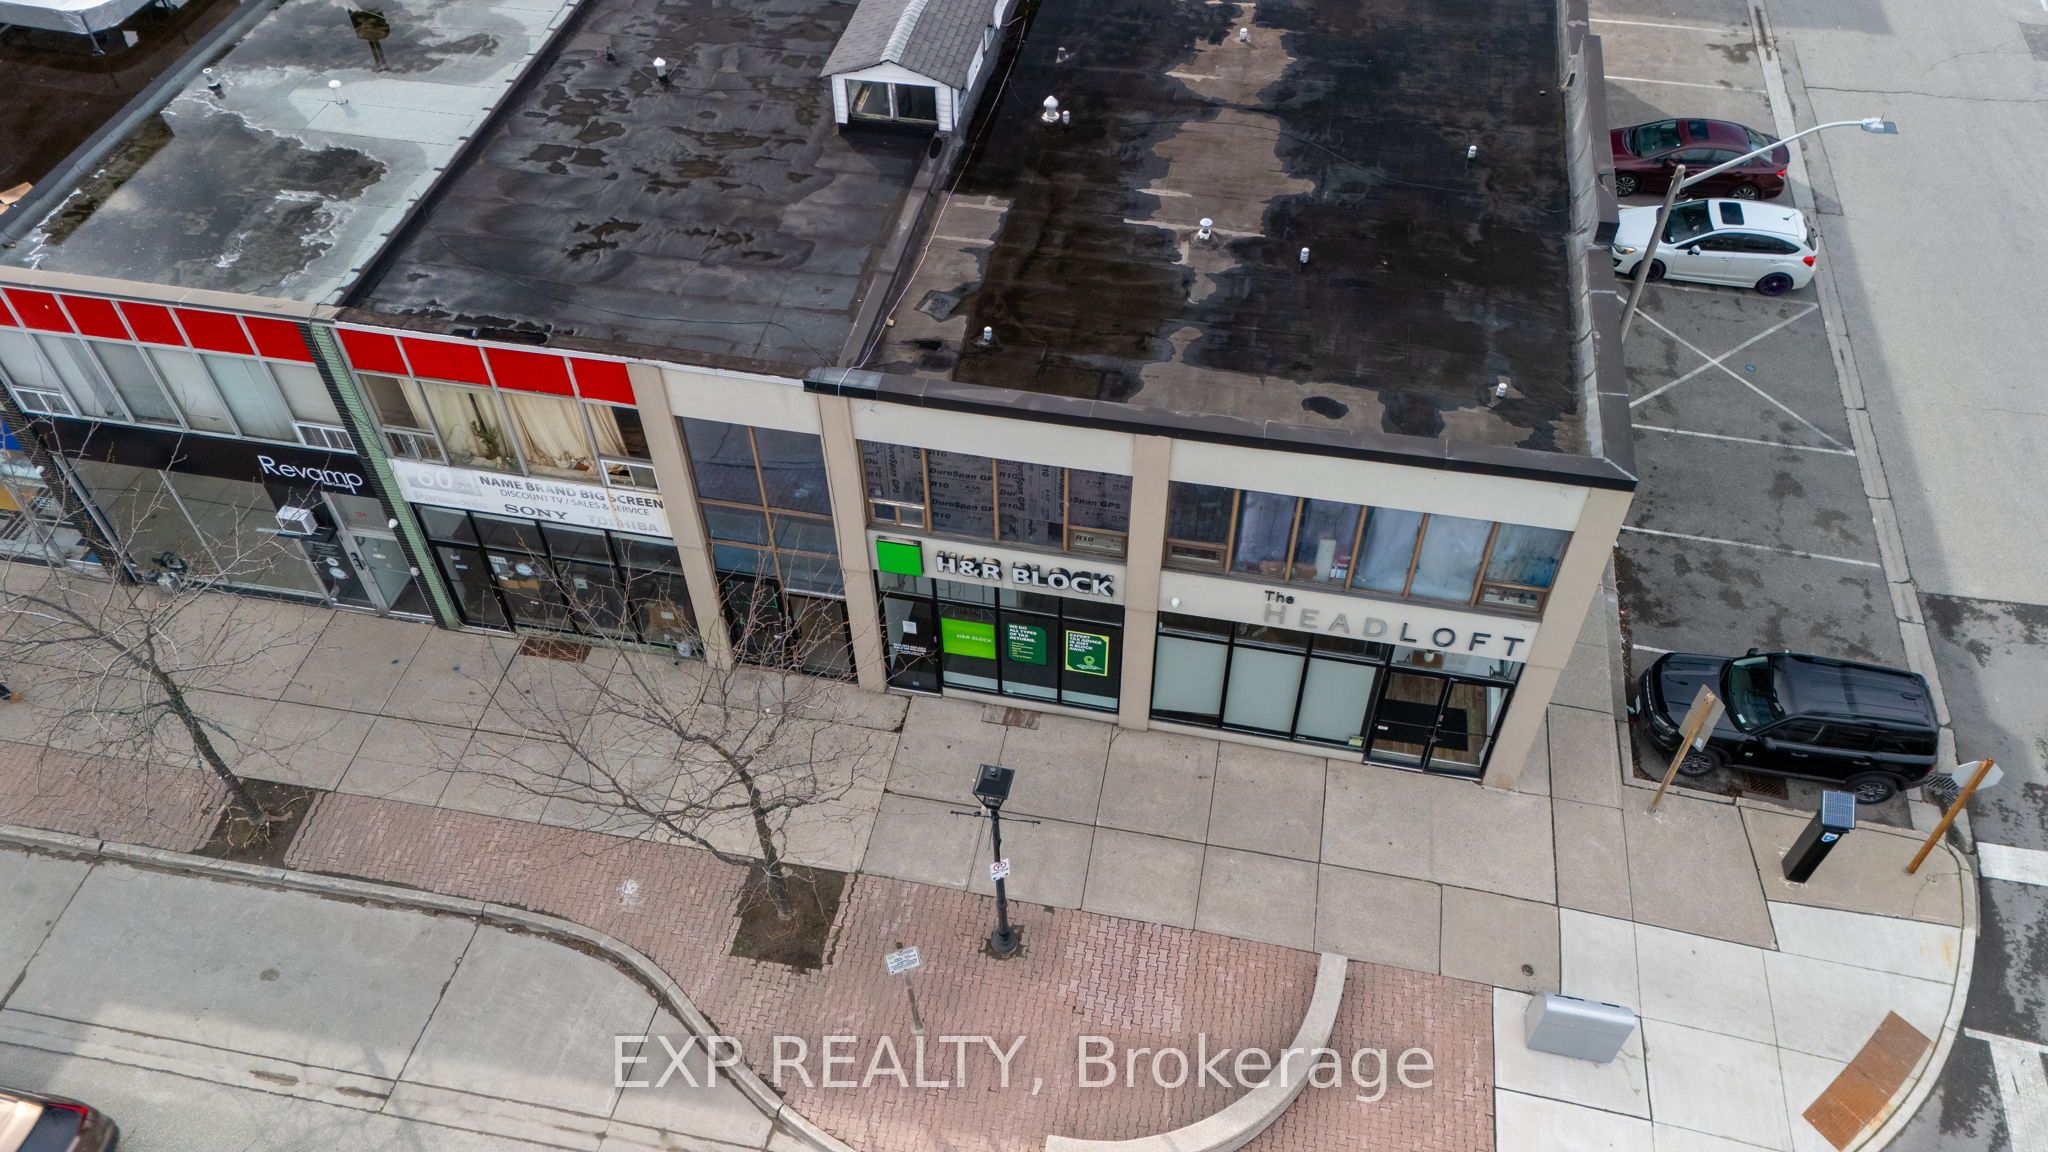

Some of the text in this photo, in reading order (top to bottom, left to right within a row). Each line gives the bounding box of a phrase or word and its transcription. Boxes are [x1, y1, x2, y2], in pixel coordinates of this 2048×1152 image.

[257, 454, 363, 495] Revamp
[929, 467, 977, 480] DuroSpan
[479, 475, 524, 490] NAME
[525, 482, 577, 498] BRAND
[580, 489, 606, 501] BIG
[609, 494, 665, 510] SCREEN
[500, 488, 549, 502] DISCOUNT
[551, 495, 563, 505] TV
[571, 500, 601, 510] SALES
[613, 505, 651, 517] SERVICE
[504, 503, 569, 520] SONY
[1100, 500, 1121, 510] GPS
[585, 514, 661, 533] TOSHIBA
[936, 551, 1115, 598] H&R BLOCK
[1264, 590, 1295, 605] The
